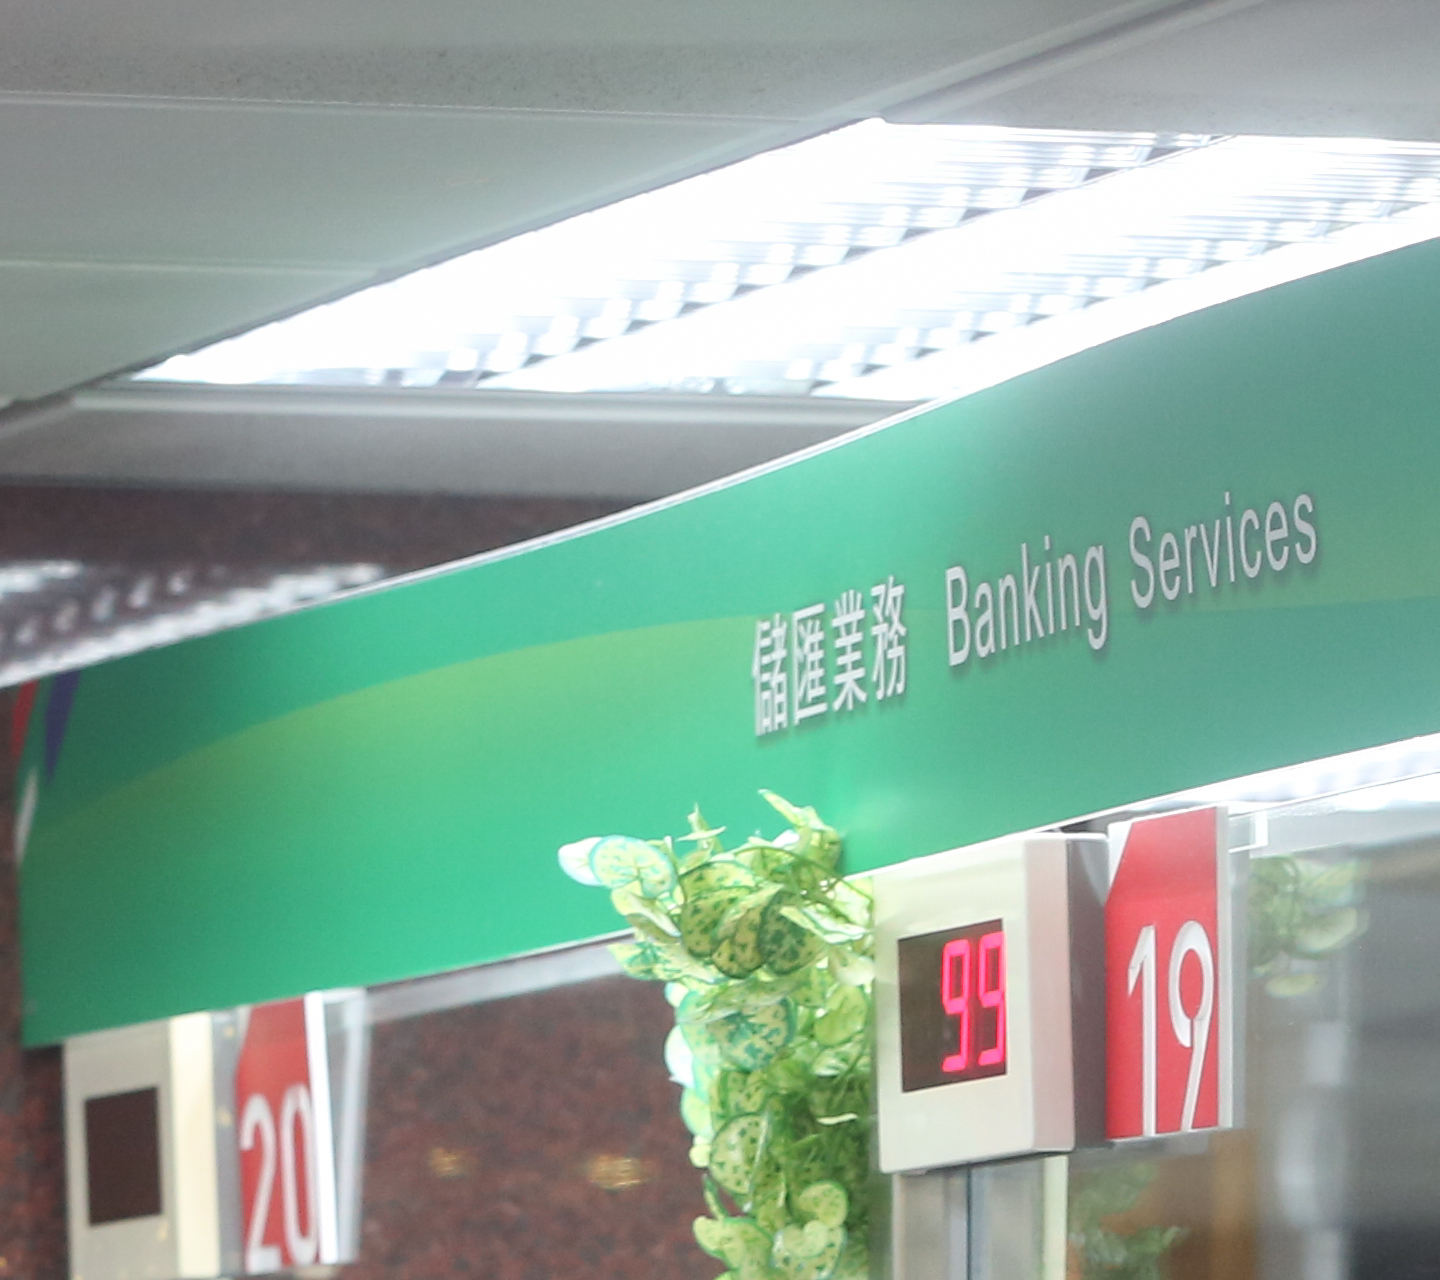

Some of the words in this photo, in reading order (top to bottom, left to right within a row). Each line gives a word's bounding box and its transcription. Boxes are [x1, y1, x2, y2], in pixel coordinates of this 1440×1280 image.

[751, 574, 908, 736] 儲匯業務
[945, 533, 1109, 668] Banking
[1129, 490, 1318, 611] Services
[940, 930, 1007, 1074] 99
[1126, 919, 1214, 1135] 19
[241, 1081, 317, 1270] 20
